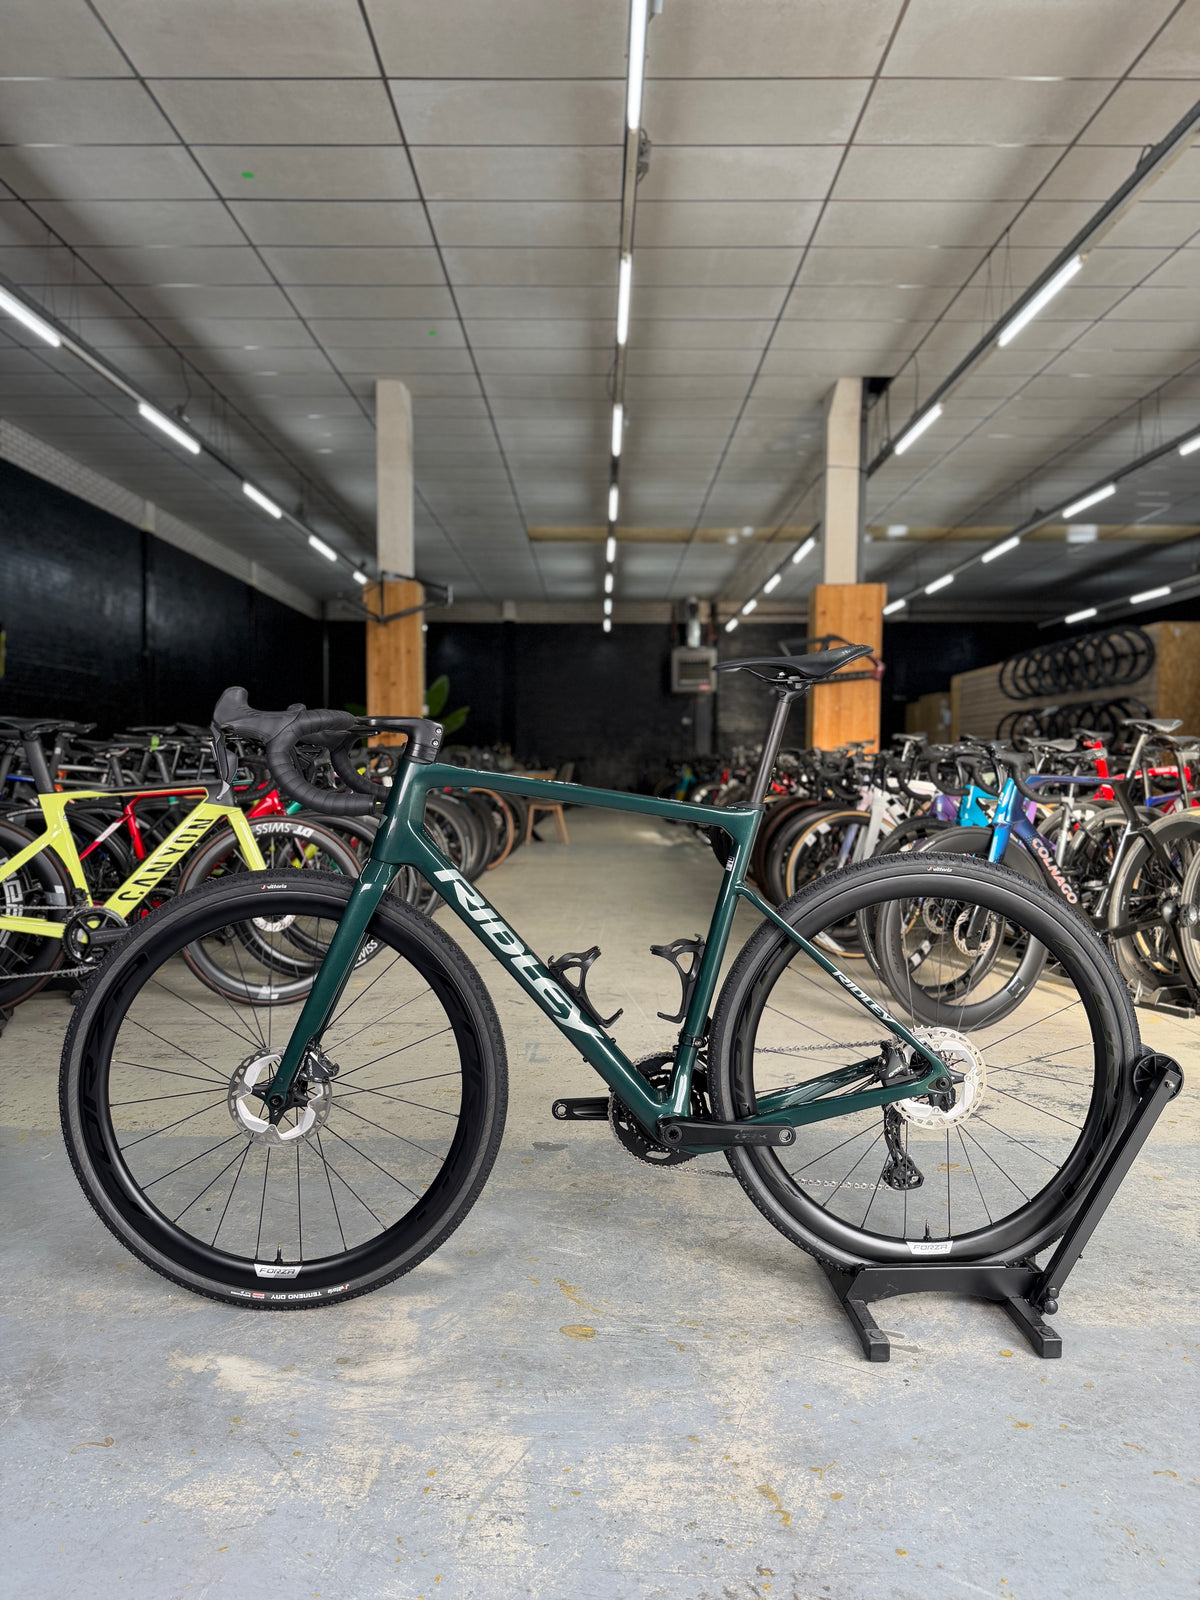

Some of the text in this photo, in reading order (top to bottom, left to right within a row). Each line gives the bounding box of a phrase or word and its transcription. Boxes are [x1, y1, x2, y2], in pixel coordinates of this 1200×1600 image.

[255, 822, 315, 838] DT SWISS
[118, 818, 214, 901] CANYON
[1032, 838, 1078, 904] COLNAGO
[358, 939, 378, 961] WISS
[433, 868, 604, 1039] RIDLEY
[832, 970, 897, 1022] RIDLEY
[259, 1267, 296, 1275] FORZA
[287, 1291, 322, 1299] TERRENO
